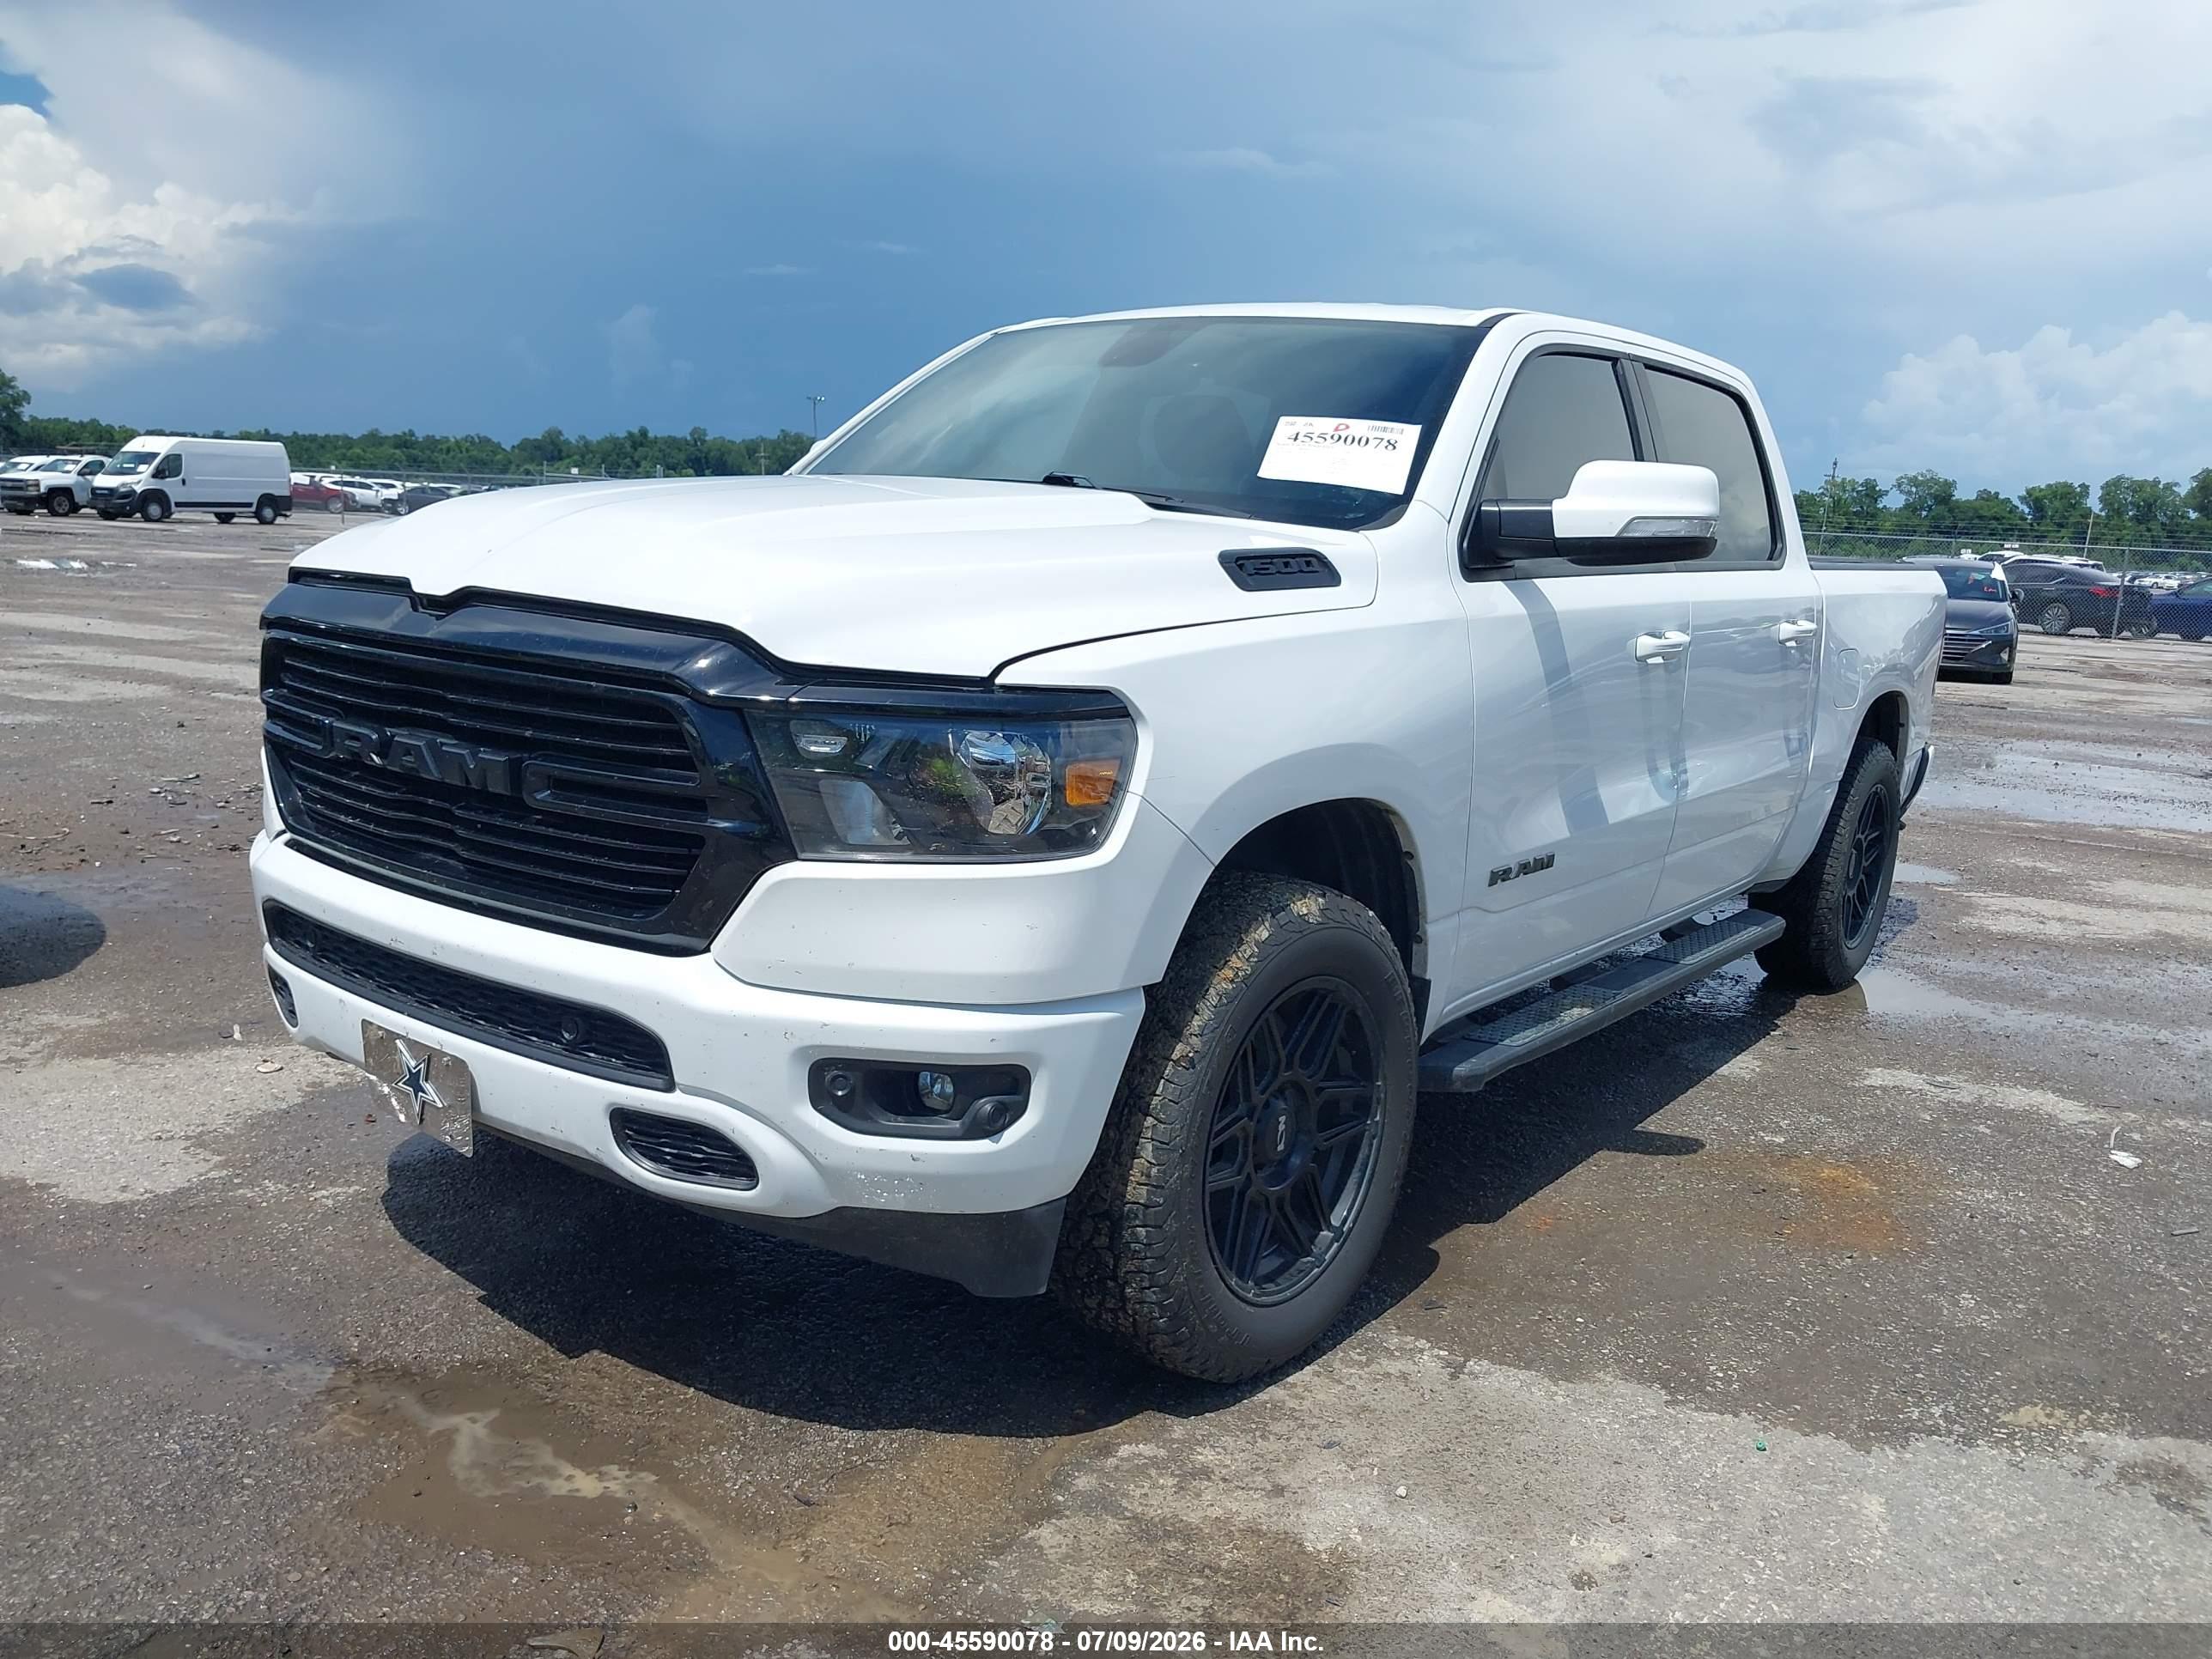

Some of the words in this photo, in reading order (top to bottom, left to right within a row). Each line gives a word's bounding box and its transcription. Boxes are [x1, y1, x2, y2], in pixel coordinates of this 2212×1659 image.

[1286, 431, 1399, 452] 45590078
[332, 720, 519, 796] RAM
[1487, 851, 1555, 887] RAM
